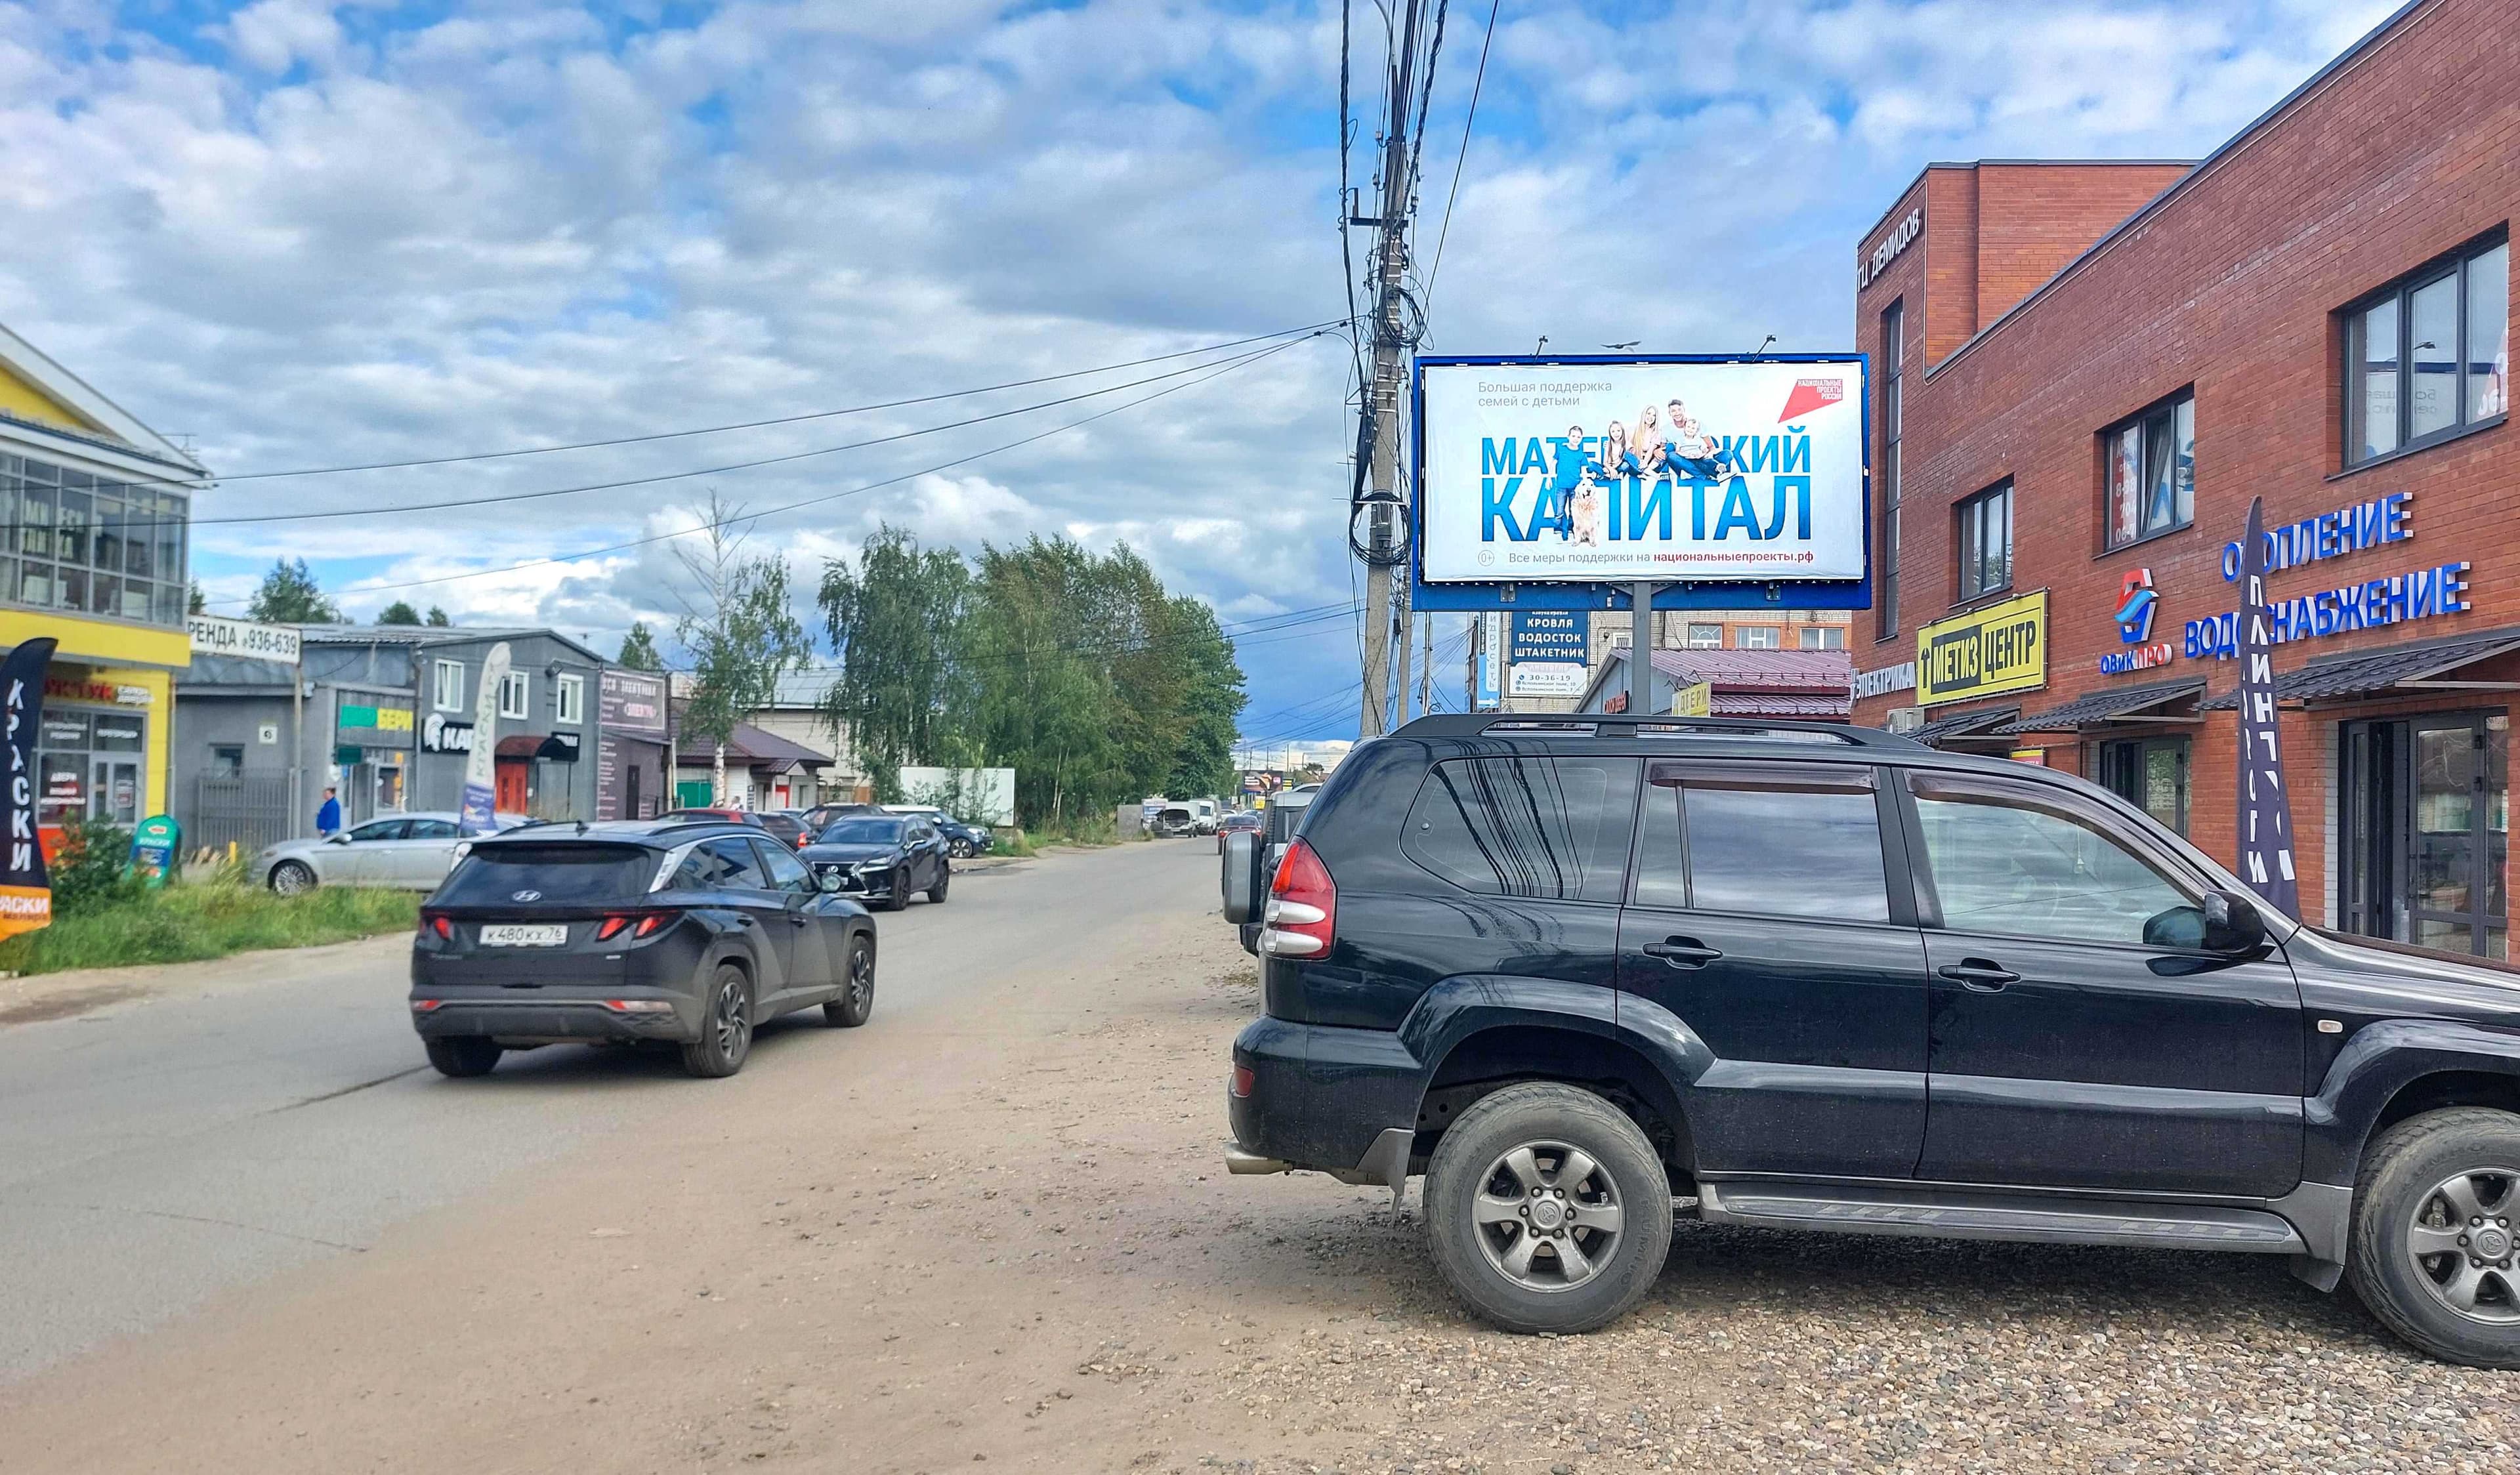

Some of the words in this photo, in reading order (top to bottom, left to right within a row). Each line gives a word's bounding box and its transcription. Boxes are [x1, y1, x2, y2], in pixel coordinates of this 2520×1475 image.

[1871, 208, 1920, 282] ДЕМИДОВ
[1478, 381, 1536, 392] Большая
[1540, 382, 1612, 394] поддержка
[1478, 396, 1518, 406] семей
[1521, 397, 1529, 406] с
[1532, 397, 1580, 407] детьми
[1481, 475, 1811, 541] КАПИТАЛ
[2221, 492, 2414, 582] ООПЛЕНИЕ
[1509, 552, 1530, 562] Все
[1533, 554, 1564, 564] меры
[1568, 554, 1633, 564] поддержки
[1653, 551, 1814, 564] национальныепроекты.рф
[1527, 618, 1573, 628] КРОВЛЯ
[2185, 562, 2471, 659] ВОДНАБЖЕНИЕ
[188, 621, 237, 649] РЕНДА
[249, 629, 297, 655] 936-639
[1515, 647, 1585, 657] ШТАКЕТНИК
[1519, 633, 1582, 644] ВОДОСТОК
[1933, 634, 1979, 684] МЕТИЗ
[1984, 620, 2036, 680] ЦЕНТР
[1856, 661, 1916, 699] ЭЛЕКТРИКА
[1680, 688, 1707, 715] ДВЕРИ
[7, 678, 32, 872] КРАСКИ
[0, 896, 49, 914] АСКИ
